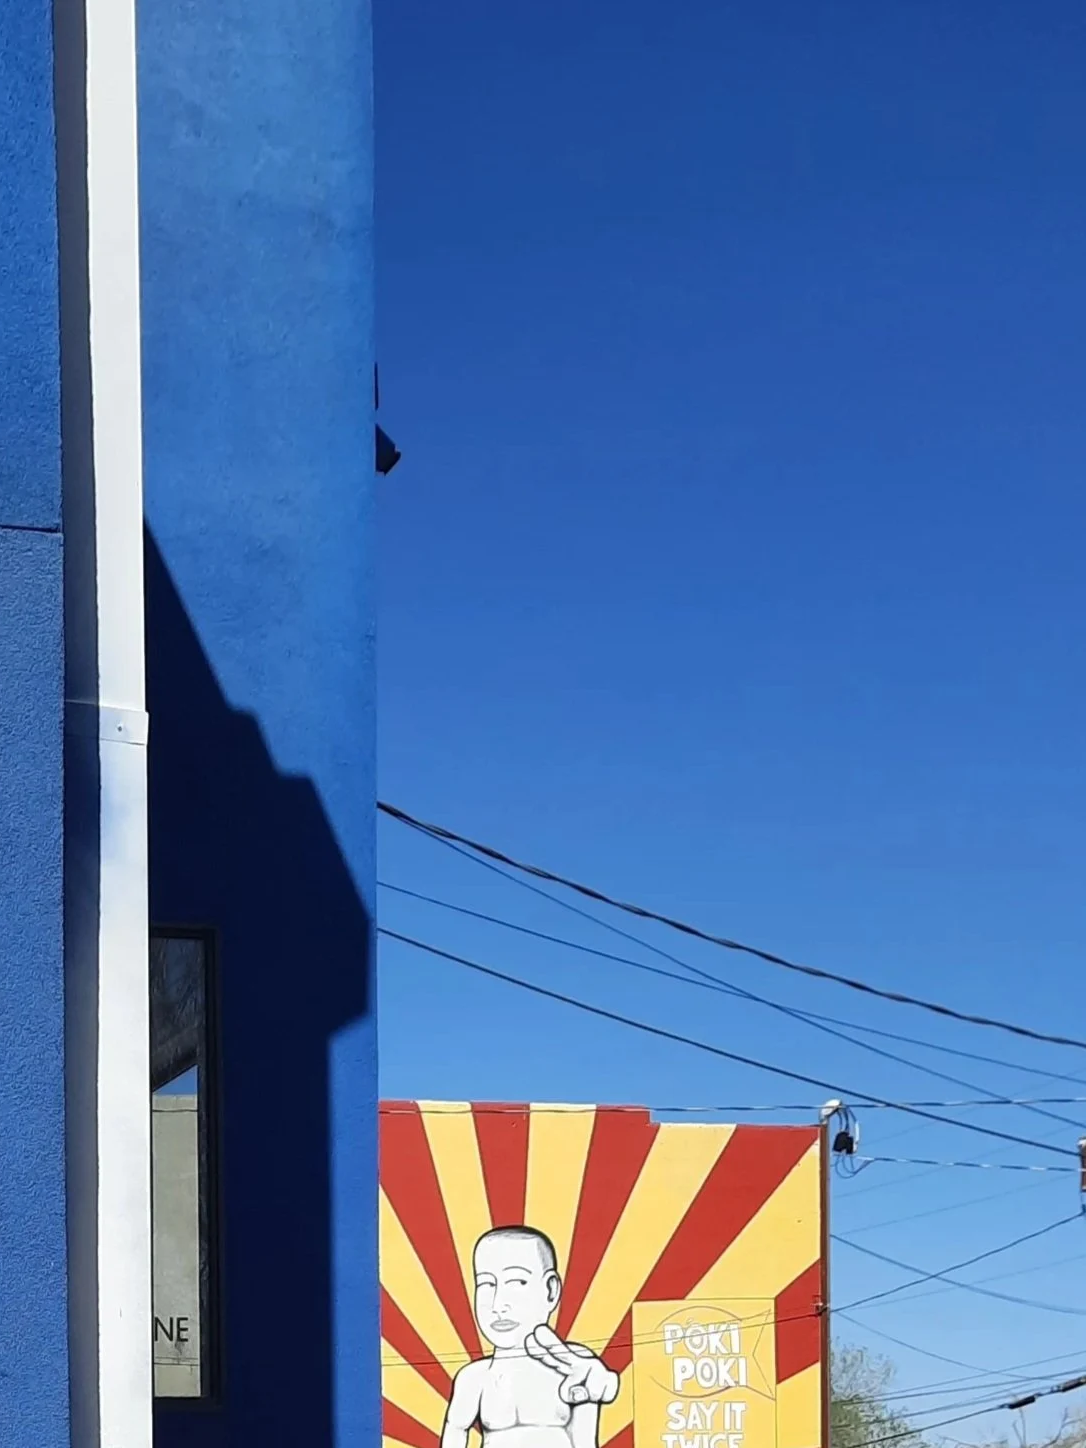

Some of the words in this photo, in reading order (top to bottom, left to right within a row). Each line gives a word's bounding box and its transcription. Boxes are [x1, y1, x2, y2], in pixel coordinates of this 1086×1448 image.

[672, 1356, 748, 1393] POKI
[666, 1399, 719, 1432] SAY
[723, 1401, 747, 1431] IT
